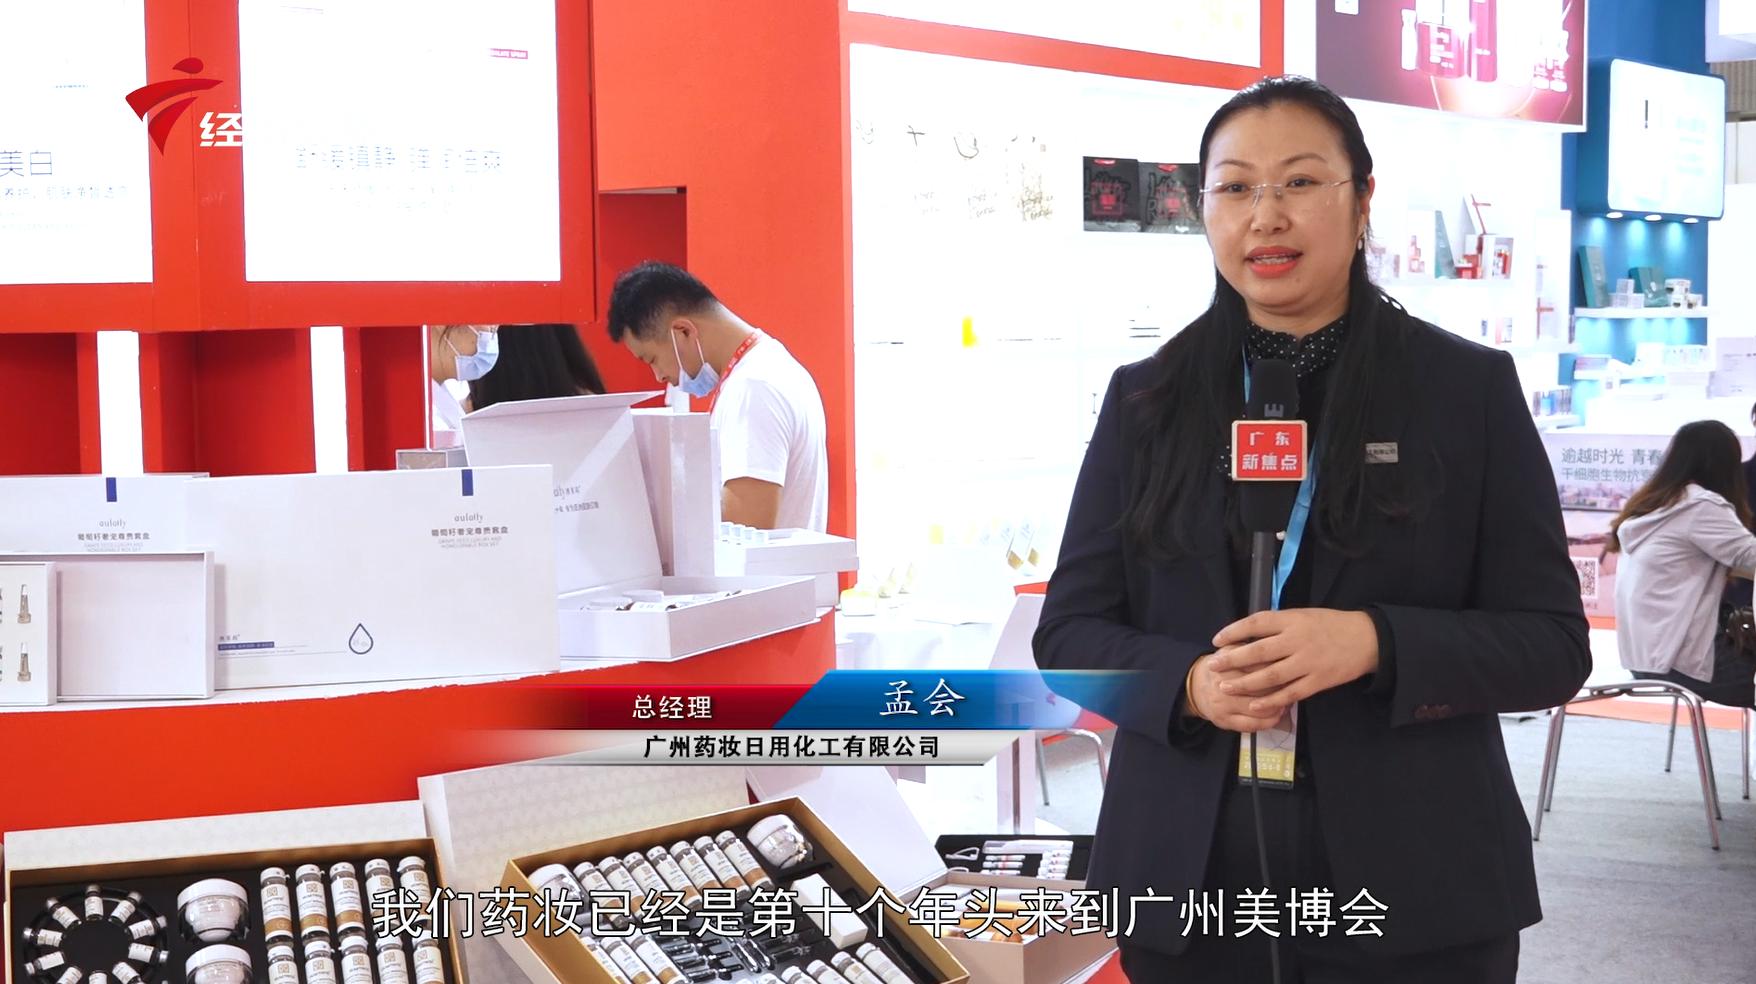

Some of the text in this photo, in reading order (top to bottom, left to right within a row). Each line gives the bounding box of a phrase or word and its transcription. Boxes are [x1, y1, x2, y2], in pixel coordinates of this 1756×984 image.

[1249, 431, 1290, 447] 广东
[1241, 453, 1298, 471] 新焦点
[1561, 447, 1625, 465] 逾越时光
